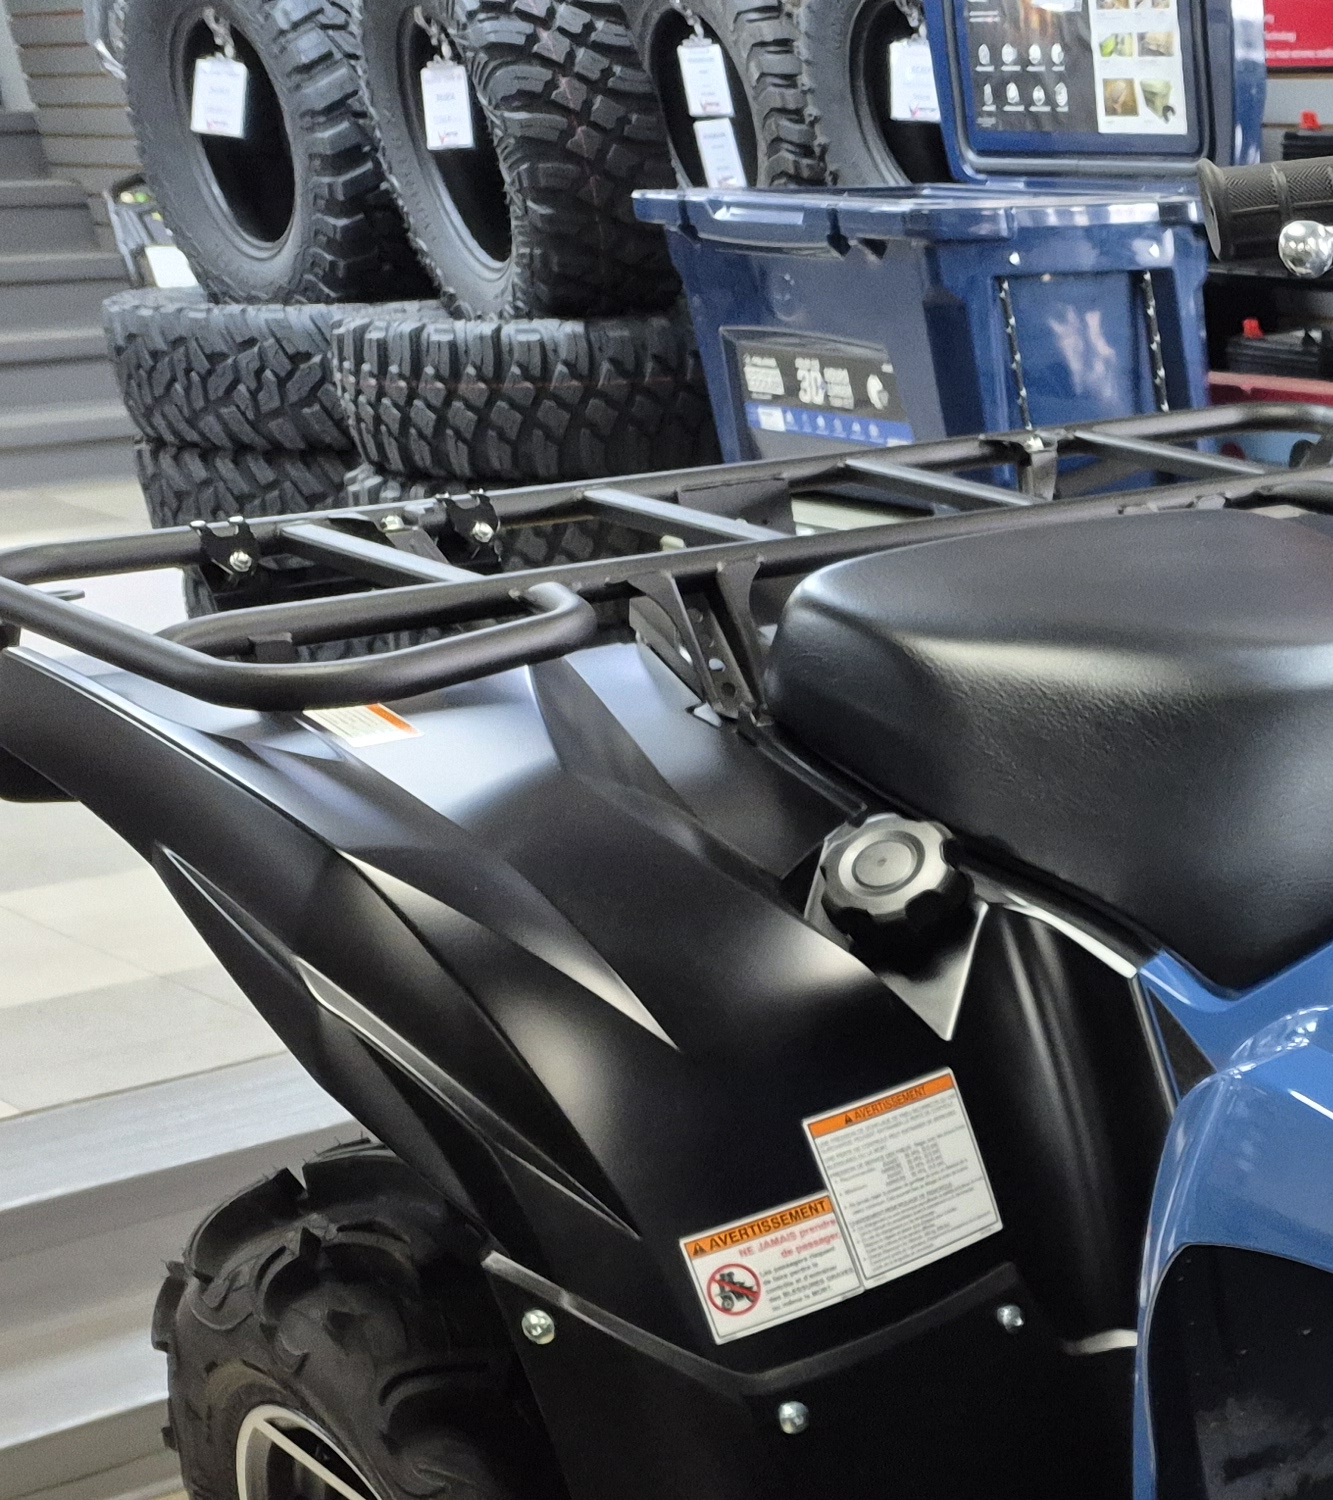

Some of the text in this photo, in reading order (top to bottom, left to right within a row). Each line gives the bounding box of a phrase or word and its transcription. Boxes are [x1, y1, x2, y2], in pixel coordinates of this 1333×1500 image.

[854, 1086, 926, 1120] AVERTISSEMENT
[709, 1201, 827, 1251] AVERTISSEMENT
[739, 1219, 838, 1258] NE JAMAIS prendre
[781, 1247, 795, 1258] de
